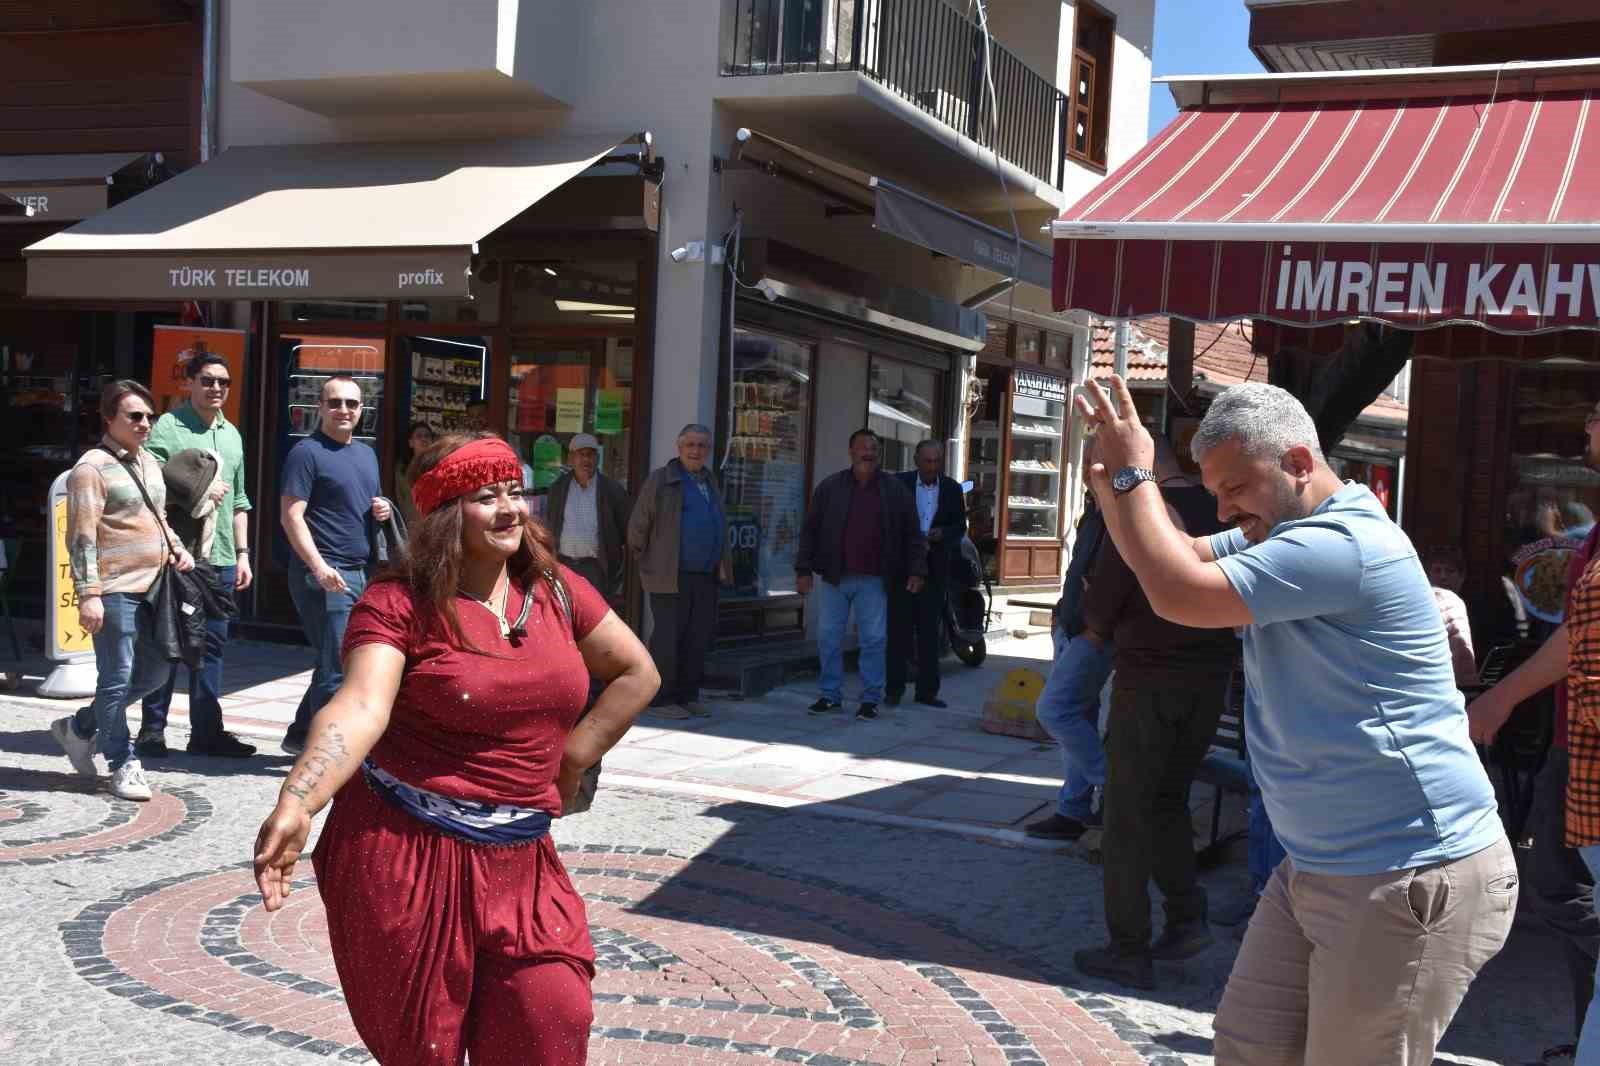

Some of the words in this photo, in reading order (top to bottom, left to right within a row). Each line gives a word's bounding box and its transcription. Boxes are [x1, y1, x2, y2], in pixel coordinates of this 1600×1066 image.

[169, 266, 216, 287] TÜRK
[225, 269, 310, 287] TELEKOM
[398, 269, 444, 289] profix
[1275, 245, 1449, 314] İMREN
